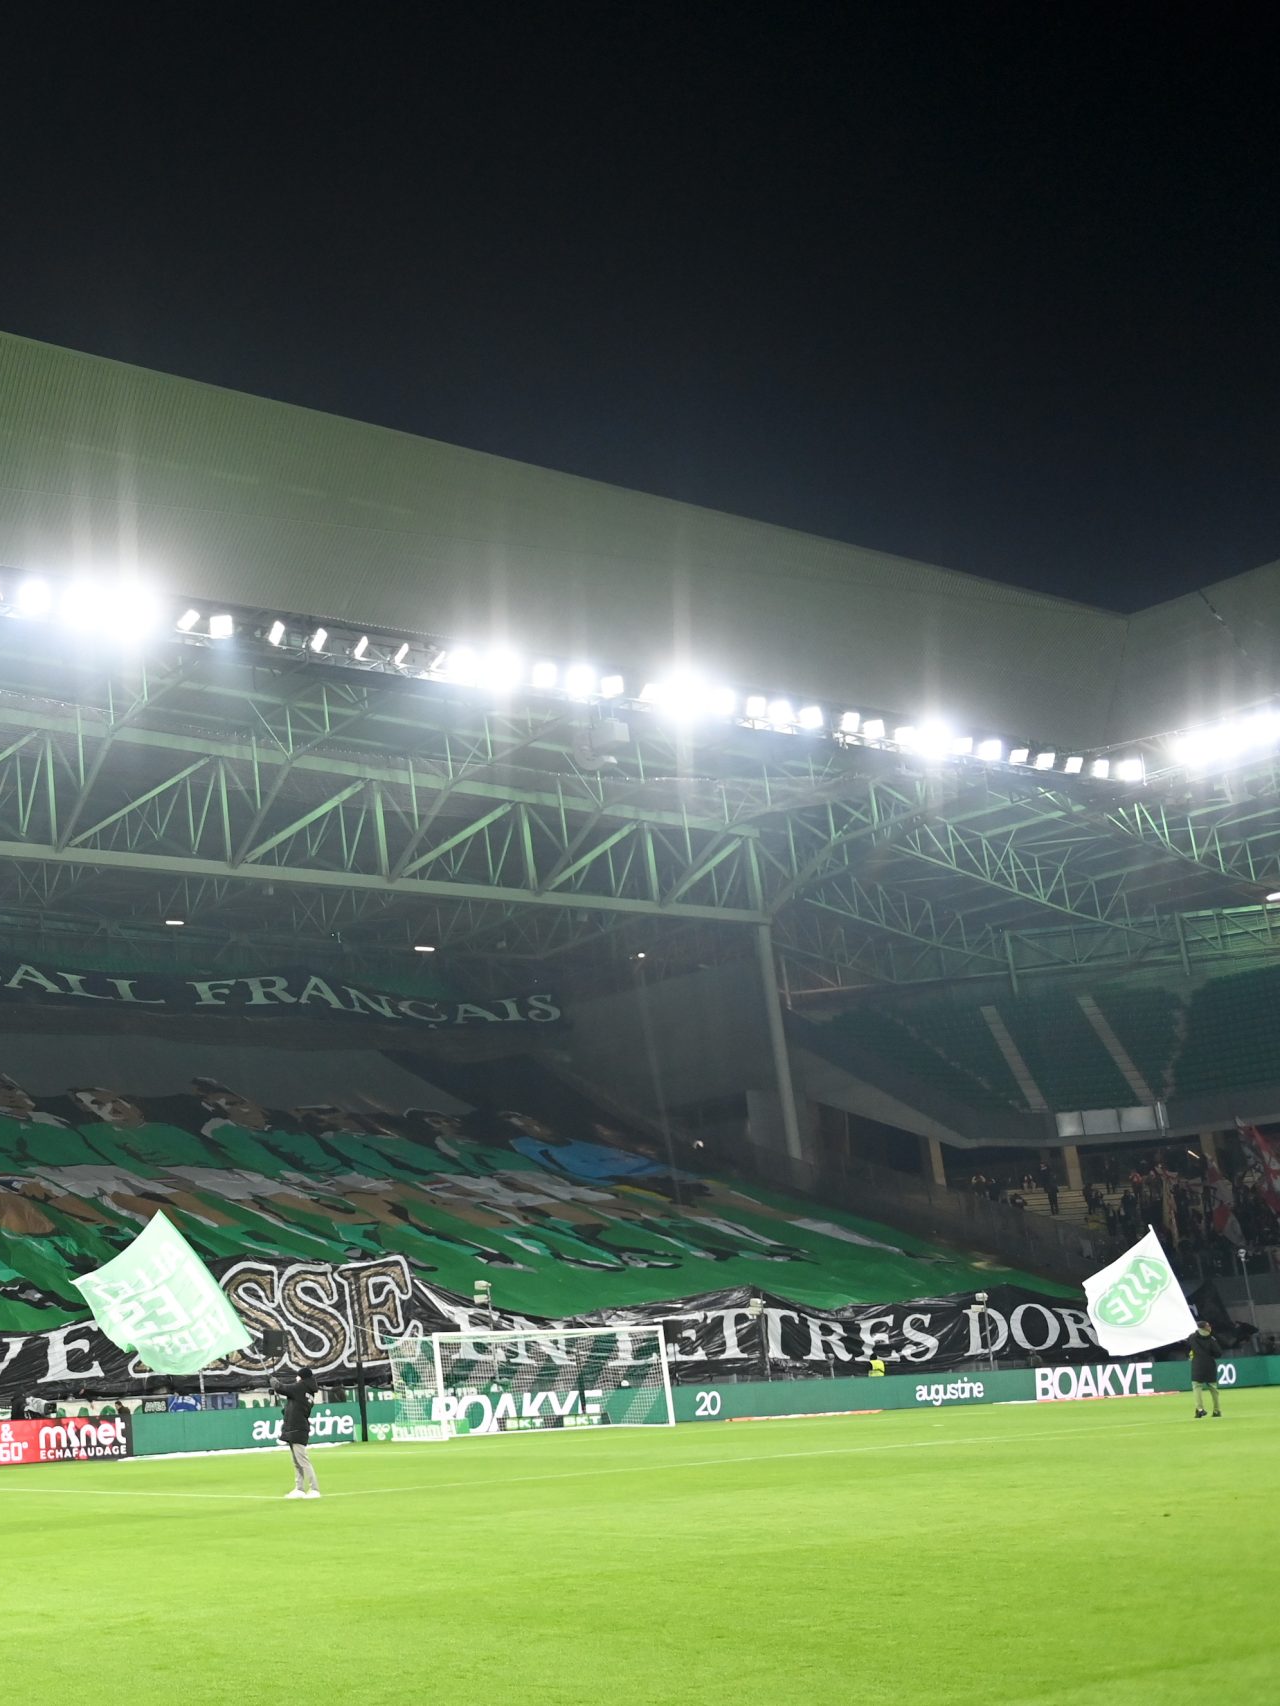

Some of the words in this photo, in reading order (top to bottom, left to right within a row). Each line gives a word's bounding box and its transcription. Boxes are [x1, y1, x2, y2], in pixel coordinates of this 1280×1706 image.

[186, 975, 563, 1030] FRANÇAIS
[128, 1255, 423, 1377] SSE
[1036, 1362, 1154, 1400] BOAKYE
[1218, 1364, 1237, 1384] 20
[916, 1377, 985, 1406] augustine
[695, 1391, 721, 1416] 20
[252, 1409, 354, 1443] austine
[391, 1420, 457, 1438] humml
[506, 1418, 542, 1430] BKT
[563, 1414, 601, 1427] BKT
[1, 1424, 14, 1442] &
[40, 1445, 127, 1459] ECHAFAUDAGE
